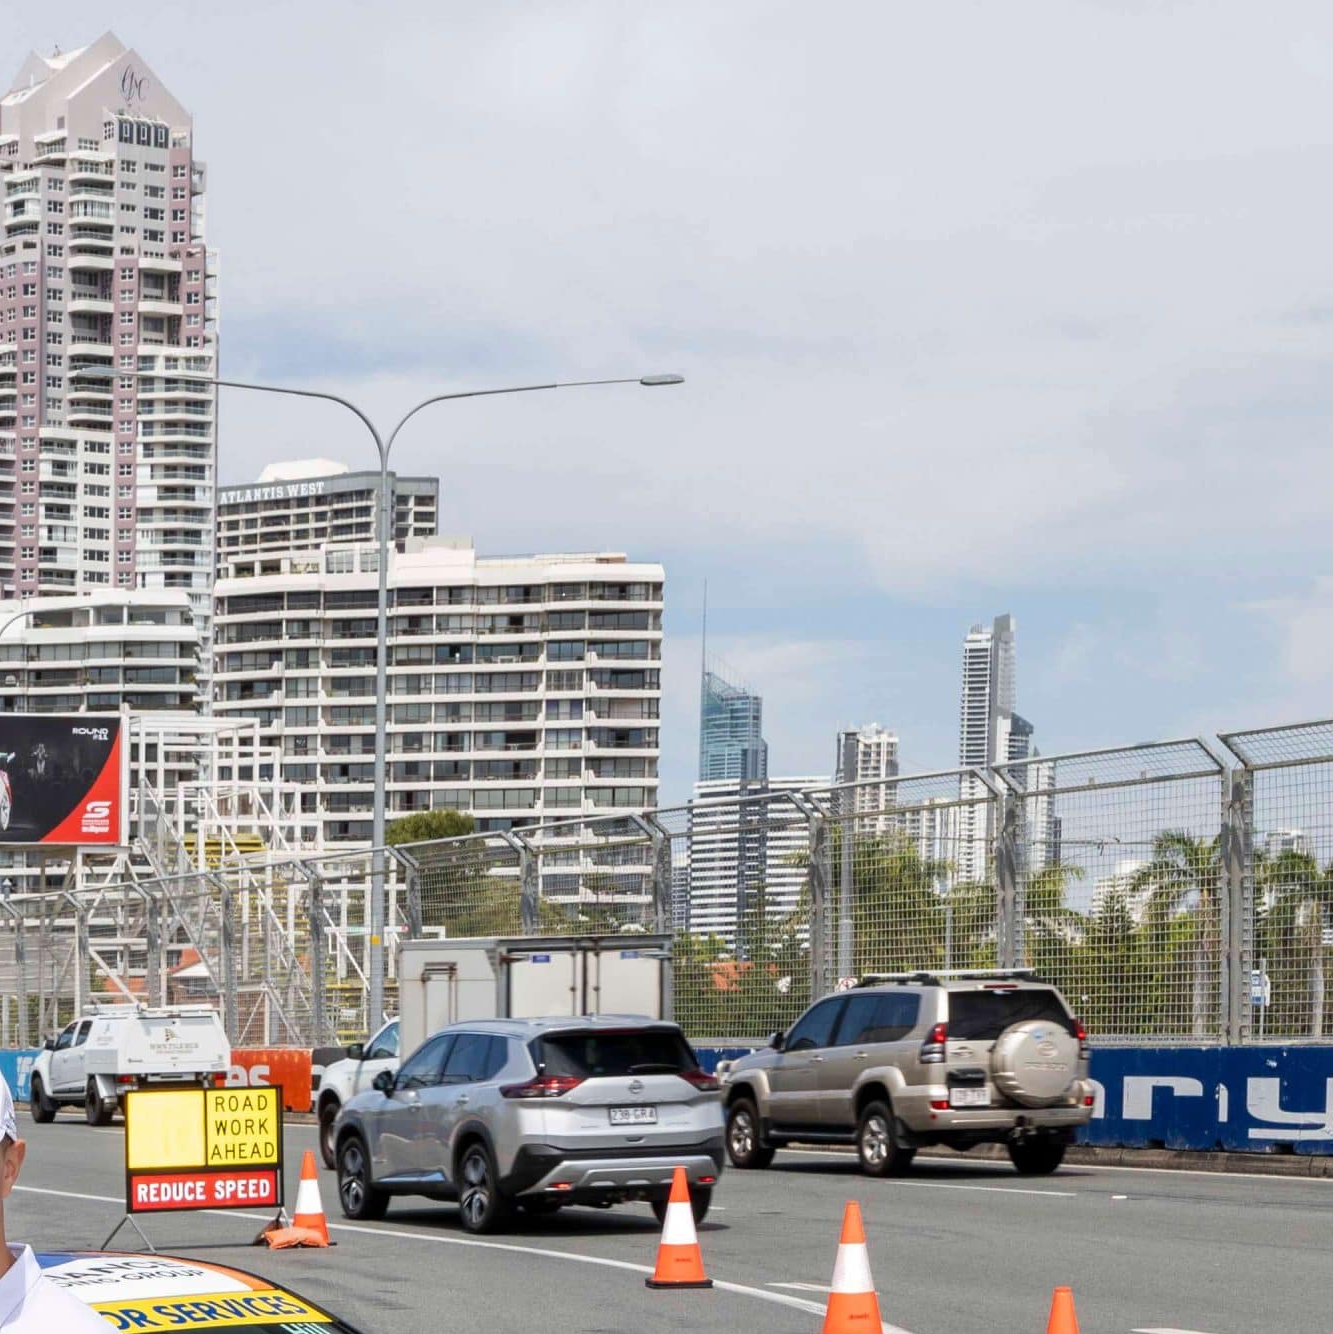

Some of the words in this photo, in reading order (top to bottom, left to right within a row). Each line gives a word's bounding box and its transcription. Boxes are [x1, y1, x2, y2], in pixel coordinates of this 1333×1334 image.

[71, 727, 109, 735] ROUND
[214, 1094, 269, 1113] ROAD
[214, 1117, 270, 1137] WORK
[210, 1141, 276, 1161] AHEAD
[136, 1180, 207, 1203] REDUCE
[214, 1178, 271, 1200] SPEED
[152, 1295, 309, 1326] SERVICES
